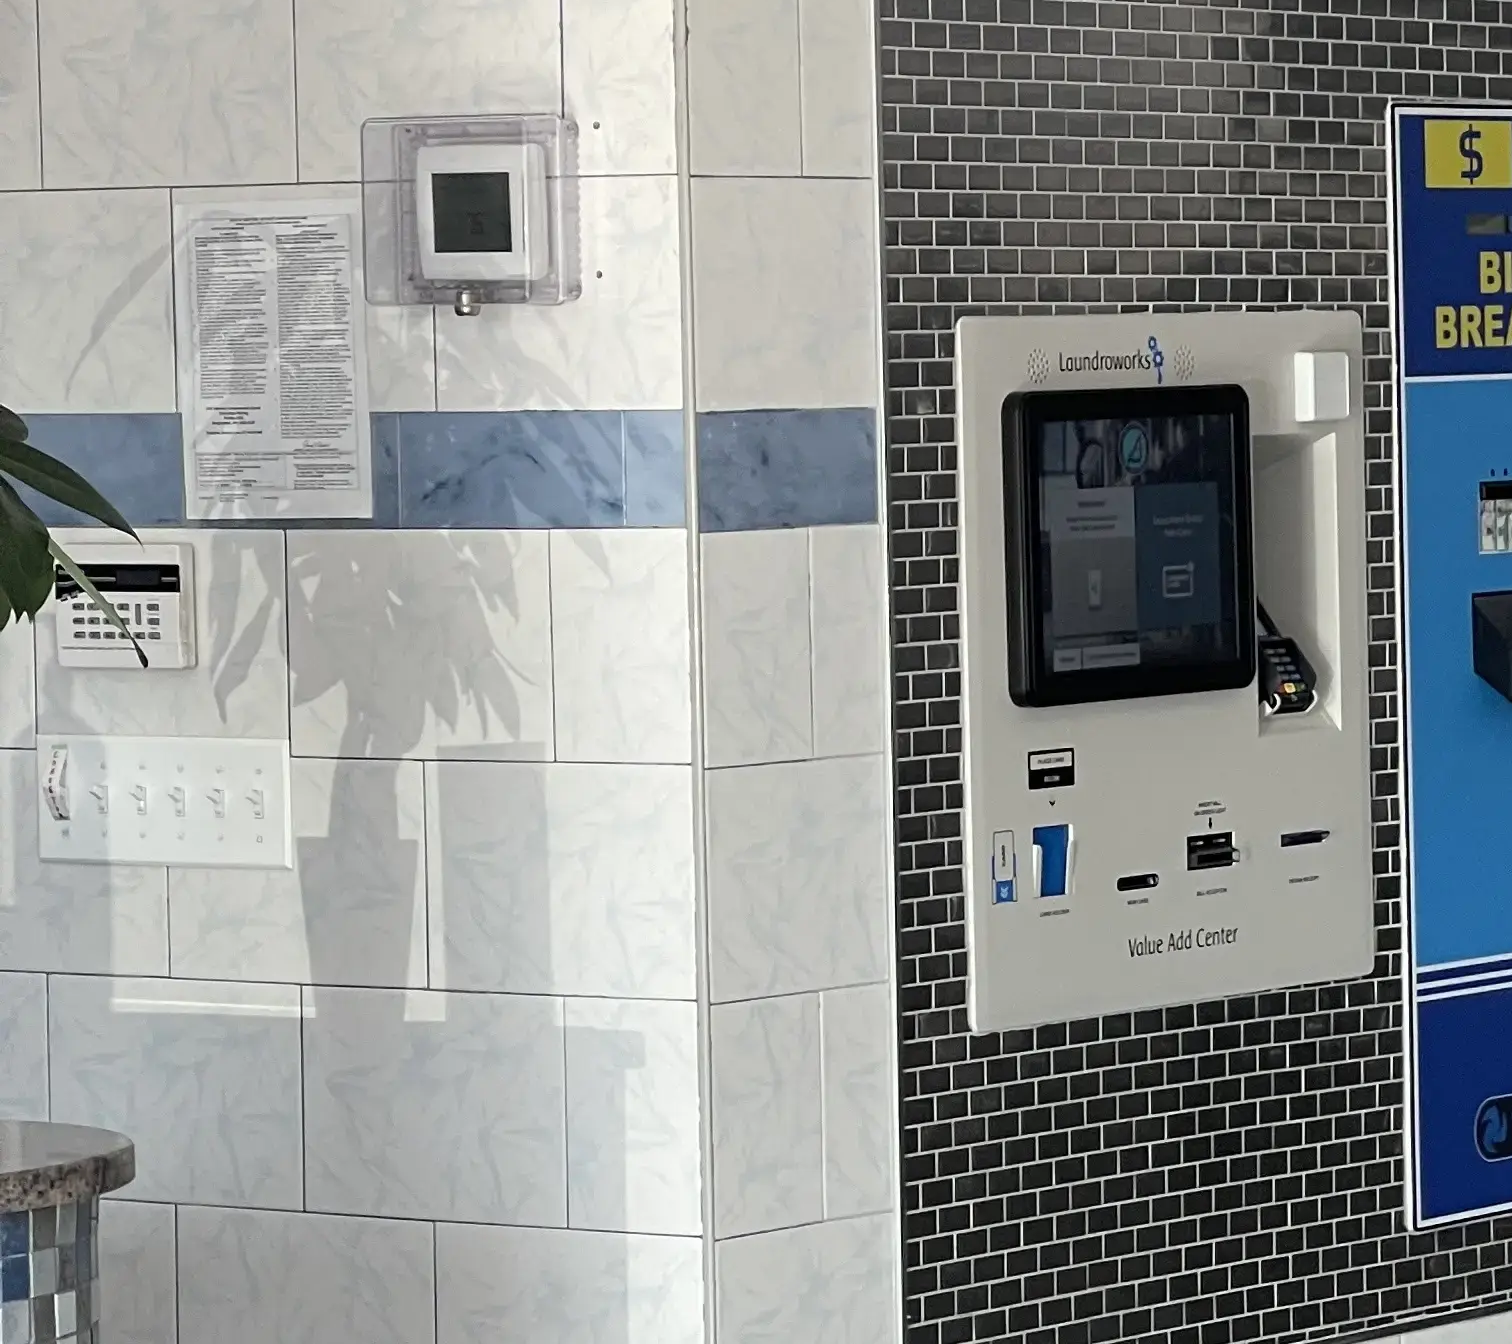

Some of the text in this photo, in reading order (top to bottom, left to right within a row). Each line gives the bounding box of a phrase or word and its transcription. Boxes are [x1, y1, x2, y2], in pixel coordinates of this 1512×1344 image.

[1058, 348, 1151, 372] Laundroworks
[1128, 927, 1239, 958] Value Add Center
